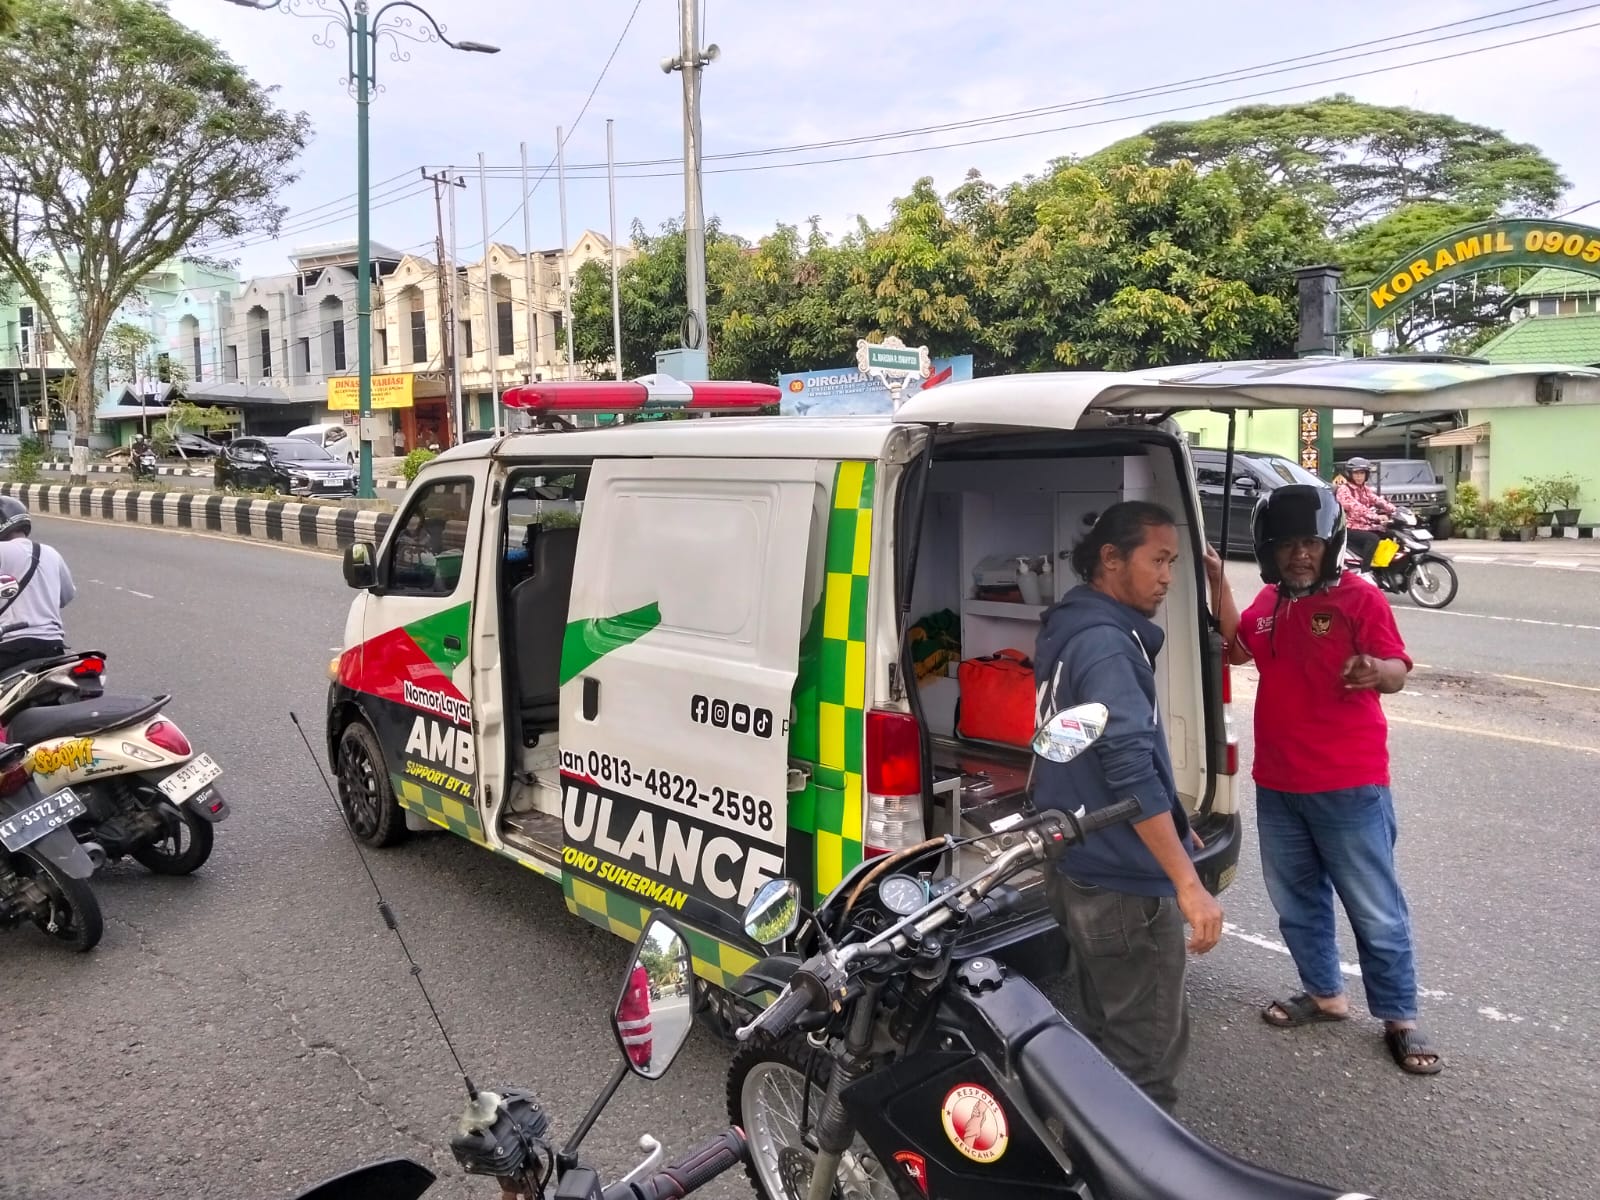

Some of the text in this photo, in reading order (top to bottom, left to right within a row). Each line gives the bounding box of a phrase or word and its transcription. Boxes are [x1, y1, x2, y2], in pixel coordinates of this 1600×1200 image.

[1370, 230, 1600, 309] KORAMIL 0905
[405, 682, 439, 707] Nomor
[405, 716, 475, 775] AMB
[163, 780, 177, 793] KT
[177, 765, 200, 783] 5312
[405, 761, 448, 786] SUPPORT
[446, 777, 461, 792] BY
[588, 751, 773, 832] 0813-4822-2598
[0, 792, 75, 838] KT 3372 ZB
[596, 861, 689, 911] SUHERMAN
[956, 1088, 999, 1113] RESPONS
[953, 1136, 996, 1159] BENCANA
